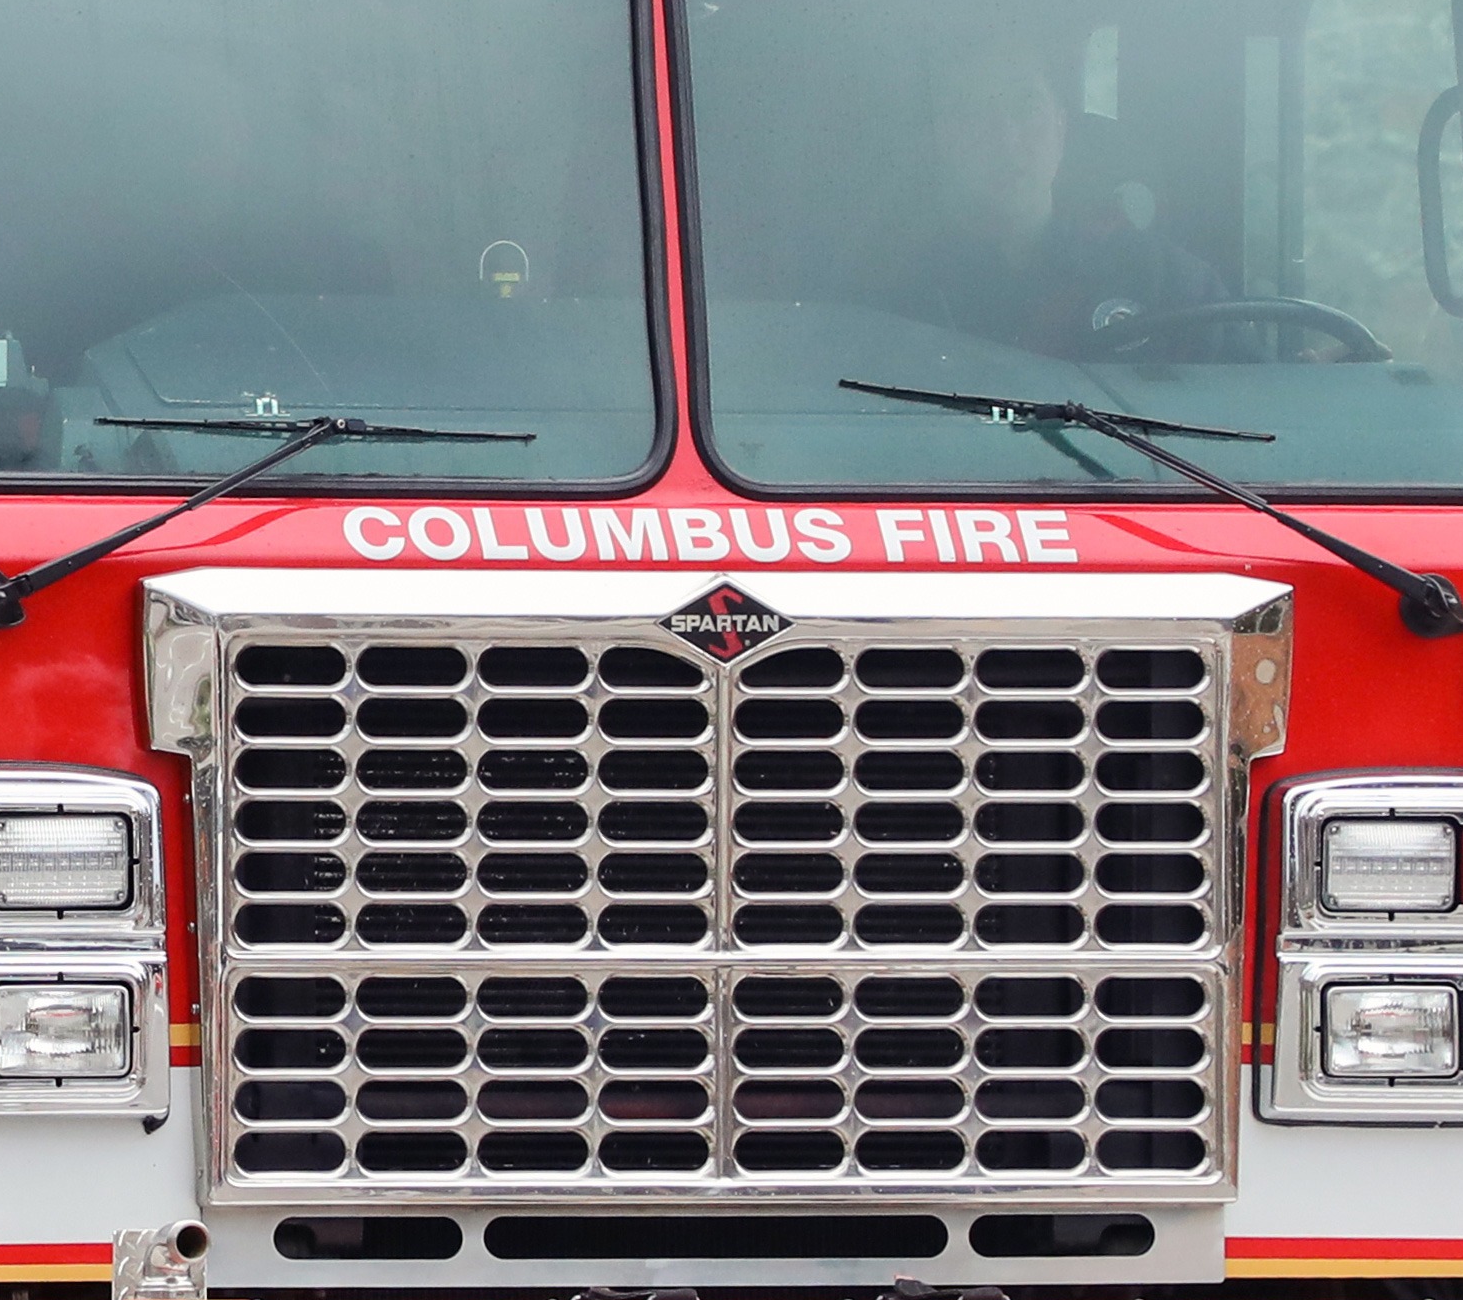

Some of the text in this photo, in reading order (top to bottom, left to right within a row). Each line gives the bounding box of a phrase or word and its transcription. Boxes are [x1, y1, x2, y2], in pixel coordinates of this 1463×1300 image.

[342, 504, 1078, 564] COLUMBUS FIRE
[670, 614, 780, 633] SPARTAN
